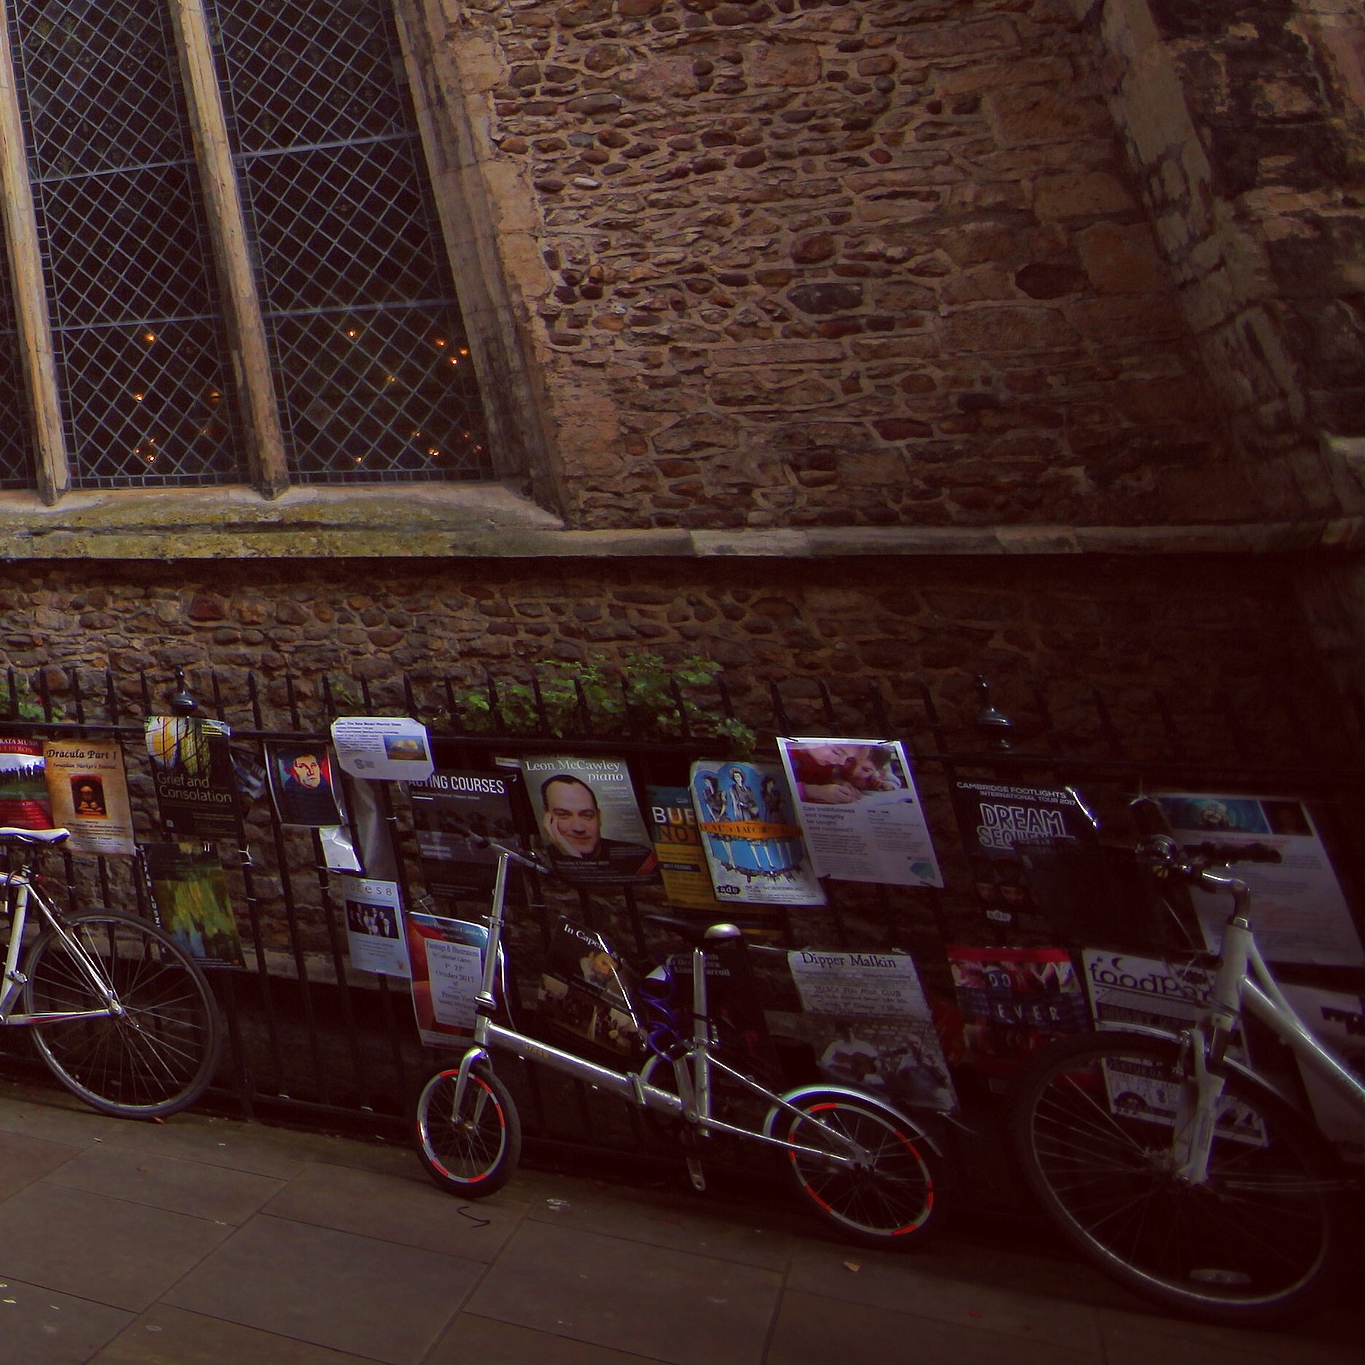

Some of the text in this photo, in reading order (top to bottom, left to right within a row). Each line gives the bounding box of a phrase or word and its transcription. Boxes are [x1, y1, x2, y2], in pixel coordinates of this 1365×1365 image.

[47, 748, 85, 759] Dracula
[87, 750, 109, 759] Part
[526, 760, 621, 772] Leon McCawley
[157, 772, 210, 788] Grief and
[588, 771, 624, 783] piano
[451, 776, 505, 794] COURSES
[957, 782, 1067, 799] CAMBRIDGE FOOTLIGHTS
[159, 785, 232, 803] Consolation
[980, 791, 1076, 806] INTERNATIONAL TOUR 2017
[979, 803, 1068, 836] DREAM
[563, 923, 574, 935] In
[800, 951, 897, 968] Dipper Malkin
[705, 968, 731, 977] arroll
